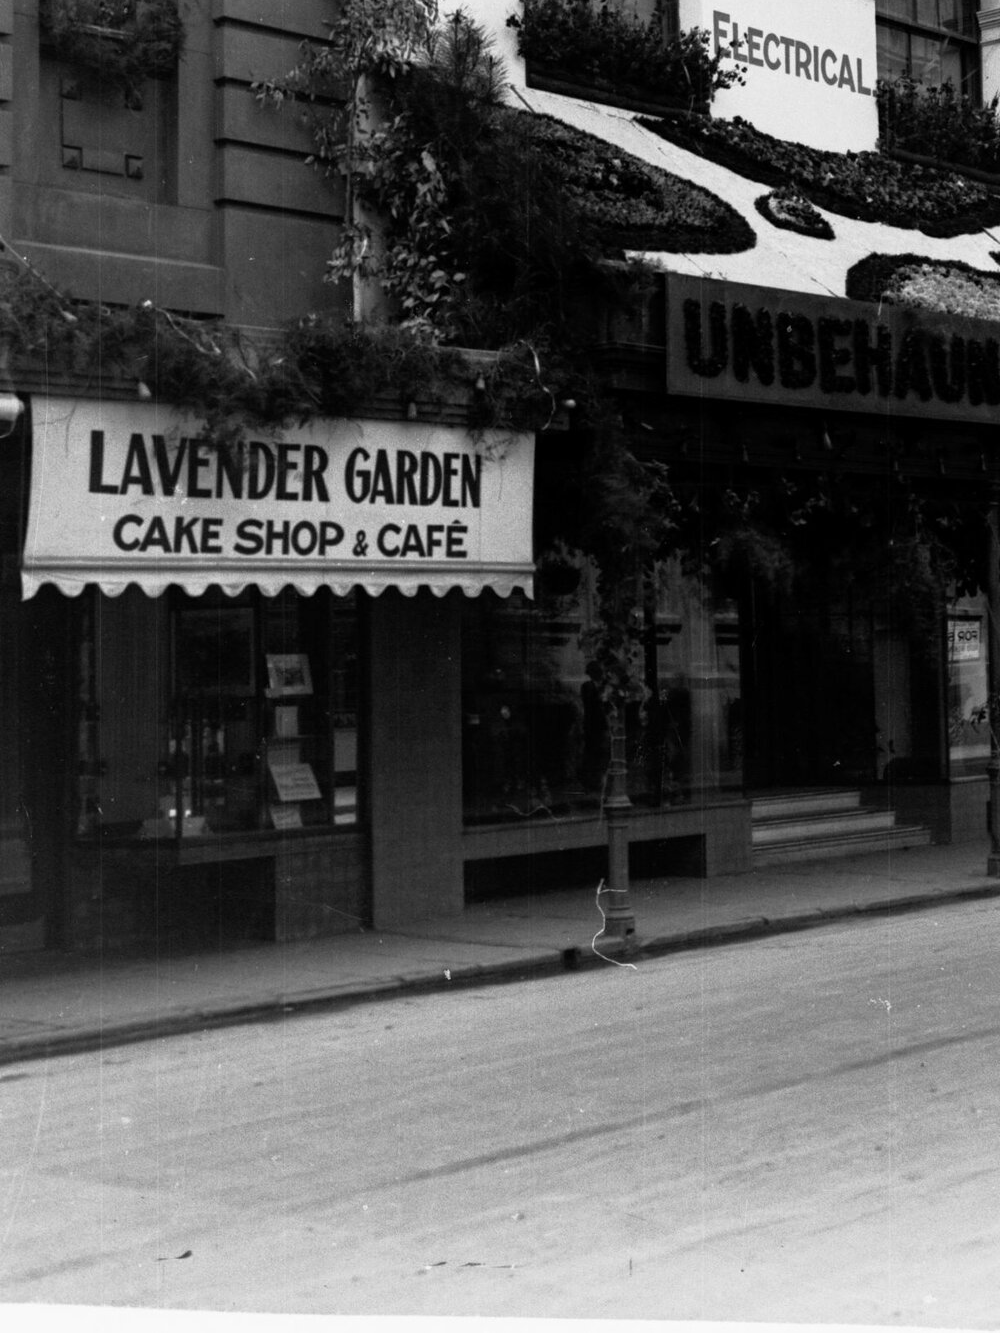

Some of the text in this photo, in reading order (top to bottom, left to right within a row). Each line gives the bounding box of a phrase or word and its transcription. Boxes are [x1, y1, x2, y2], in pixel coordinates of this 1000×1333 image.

[88, 428, 482, 508] LAVENDER GARDEN
[113, 513, 223, 554] CAKE
[234, 518, 345, 557] SHOP
[352, 529, 368, 557] &
